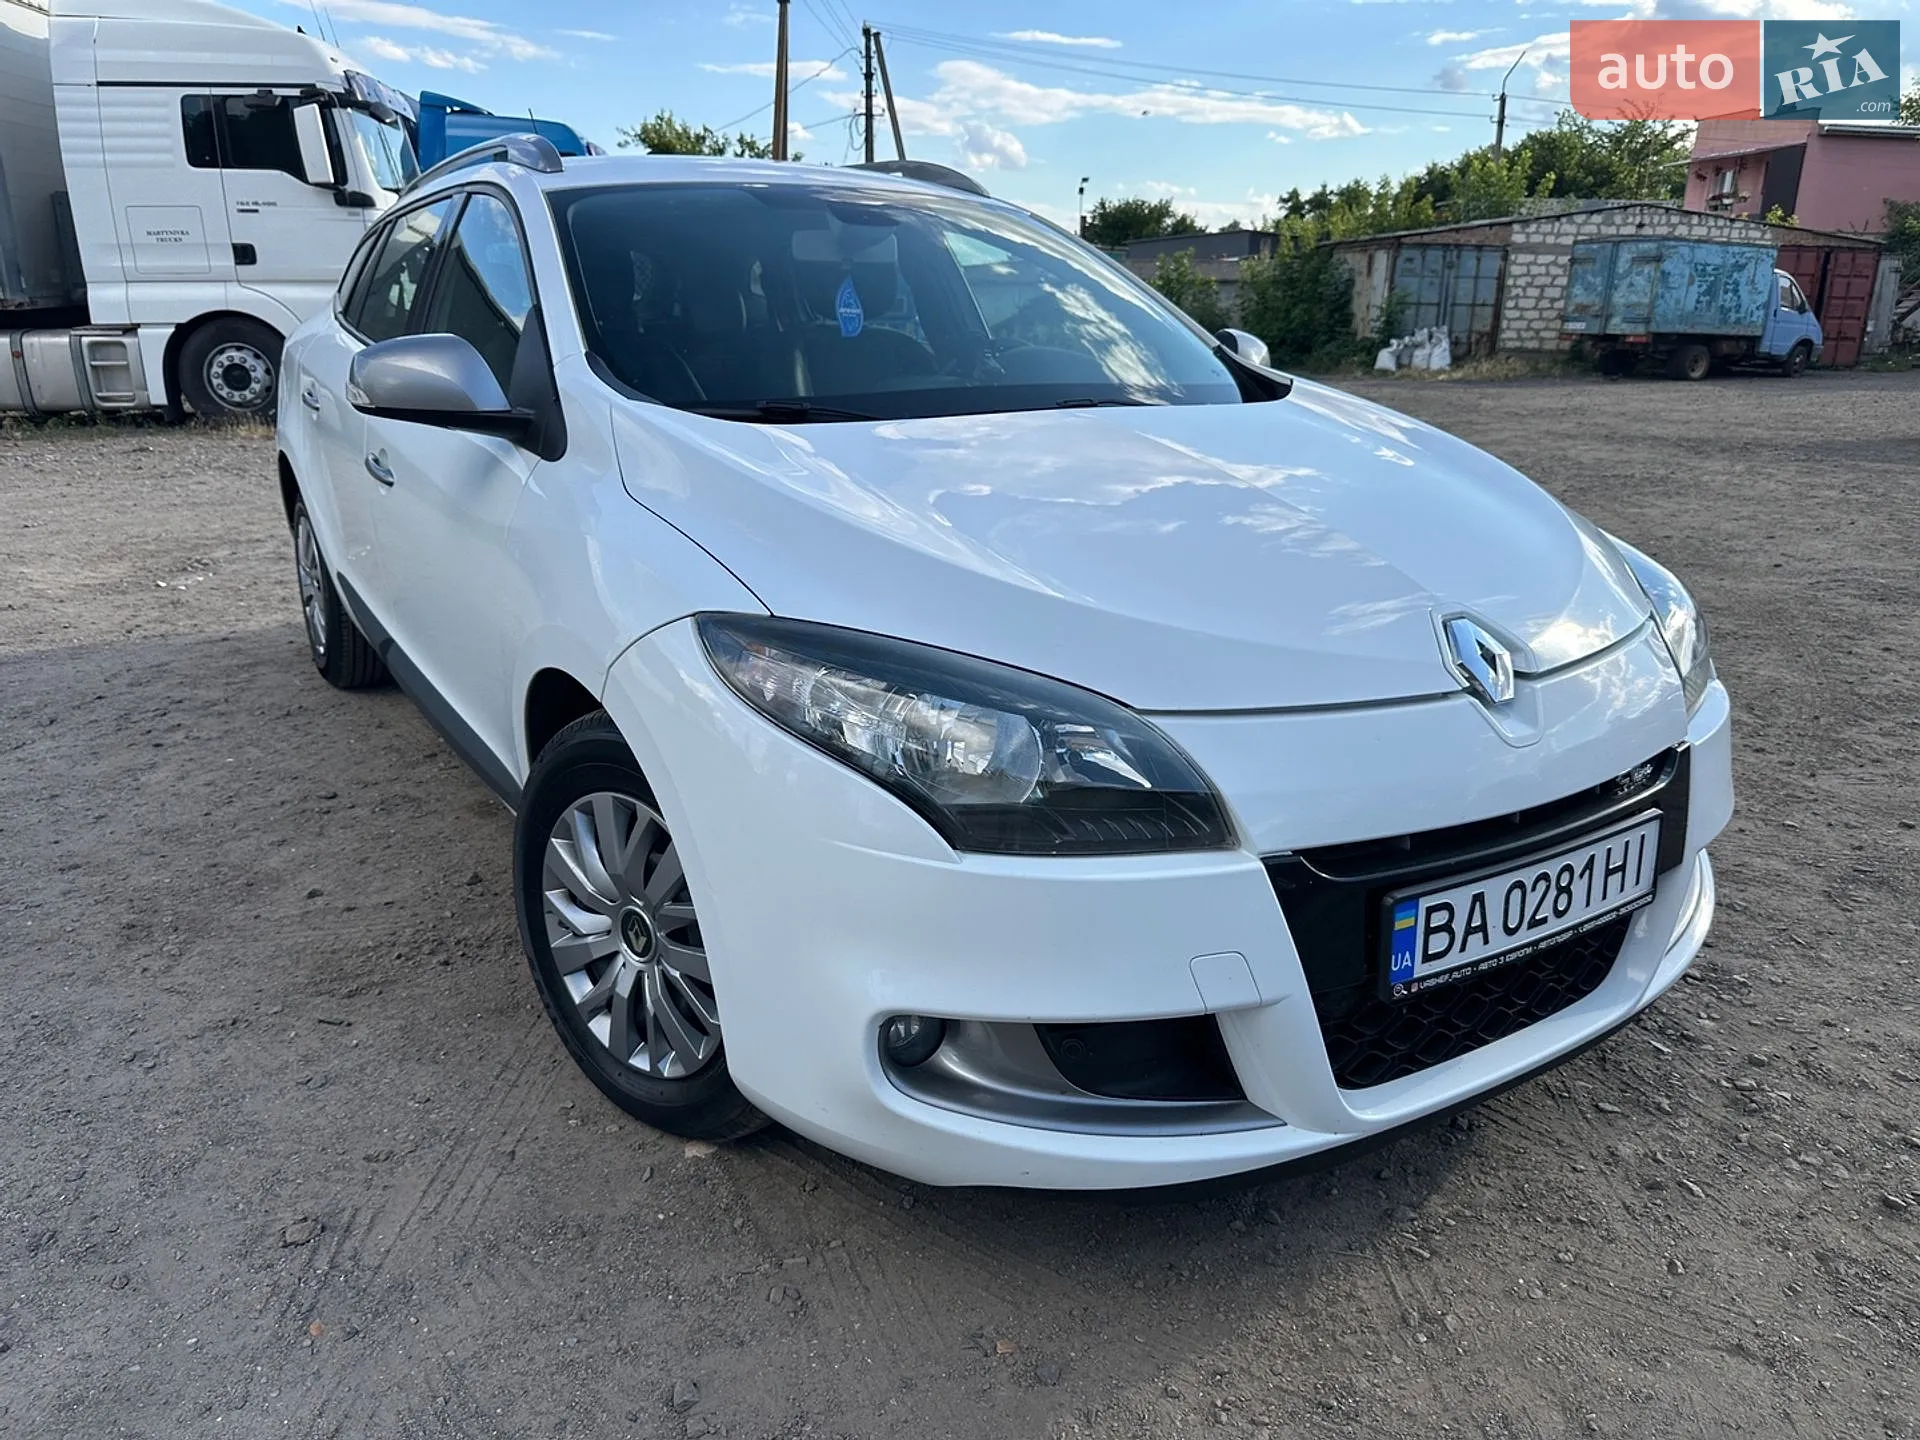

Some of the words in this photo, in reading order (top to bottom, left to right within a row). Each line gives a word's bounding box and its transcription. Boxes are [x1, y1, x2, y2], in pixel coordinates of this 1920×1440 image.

[1421, 890, 1489, 964] BA
[1502, 852, 1596, 936] 0281
[1602, 832, 1645, 900] HI
[1391, 950, 1412, 971] UA
